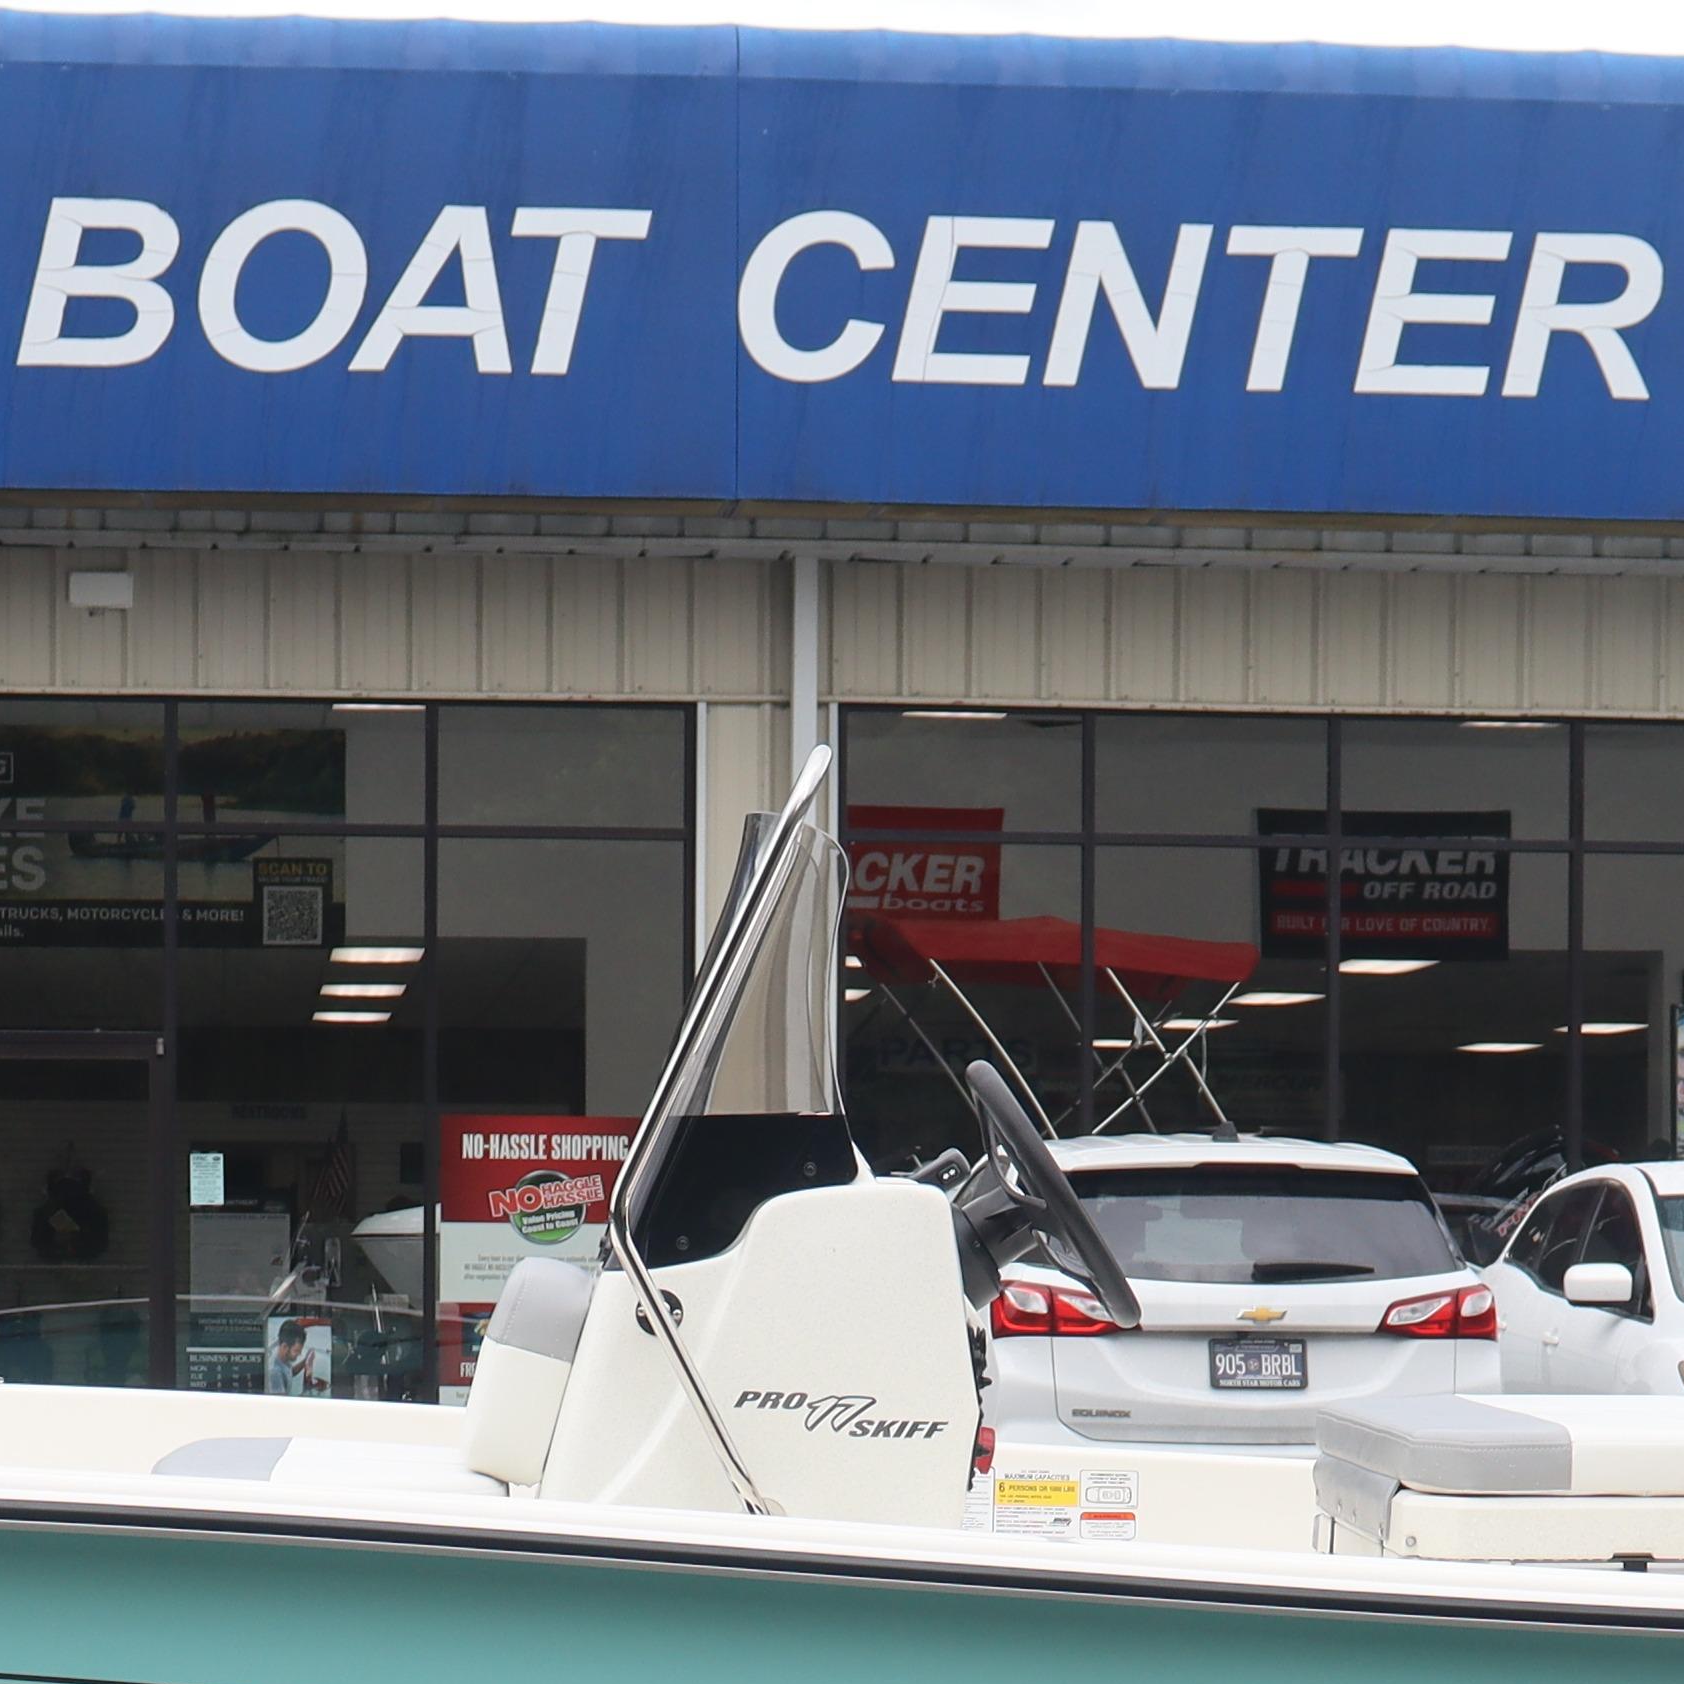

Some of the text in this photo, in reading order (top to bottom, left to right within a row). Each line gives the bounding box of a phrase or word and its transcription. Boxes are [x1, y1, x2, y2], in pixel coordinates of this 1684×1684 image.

[18, 198, 651, 374] BOAT
[739, 211, 1662, 399] CENTER
[307, 864, 327, 875] TO
[849, 851, 986, 895] CKER
[1364, 880, 1497, 900] OFF ROAD
[882, 892, 985, 912] boats
[67, 907, 178, 921] MOTORCYCLE
[182, 908, 194, 921] &
[196, 908, 245, 922] MORE!
[1321, 915, 1350, 930] FR
[1356, 915, 1393, 932] LOVE
[1399, 915, 1417, 932] OF
[1422, 915, 1492, 932] COUNTRY.
[462, 1133, 629, 1161] NO-HASSLE SHOPPING
[540, 1175, 603, 1198] HAGGLE
[488, 1184, 543, 1217] NO
[542, 1187, 605, 1210] HASSLE
[522, 1209, 576, 1224] Value Pricing
[555, 1217, 579, 1229] Coast
[189, 1354, 262, 1363] BUSINESS HOURS
[1215, 1353, 1302, 1376] 905 BRBL
[734, 1390, 949, 1439] PRO 17 SKIFF
[998, 1482, 1005, 1493] 6
